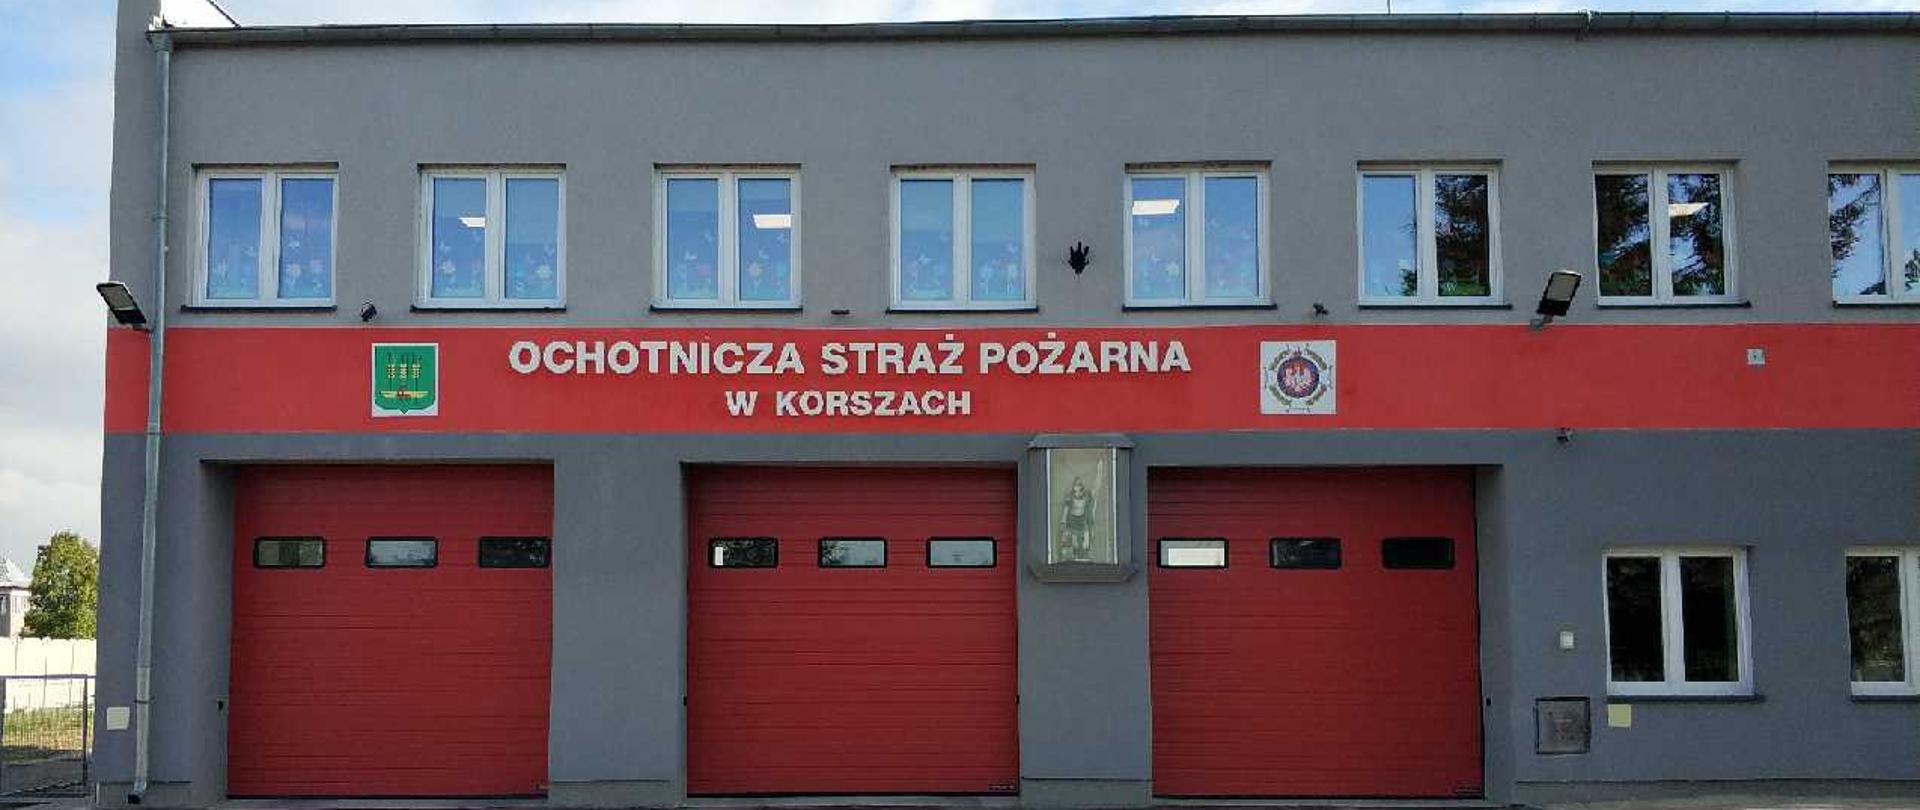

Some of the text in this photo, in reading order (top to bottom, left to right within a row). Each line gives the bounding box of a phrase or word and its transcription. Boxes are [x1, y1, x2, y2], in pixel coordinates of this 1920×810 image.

[821, 333, 965, 375] STRAŻ
[979, 332, 1192, 375] POŻARNA
[725, 390, 971, 417] W KORSZACH
